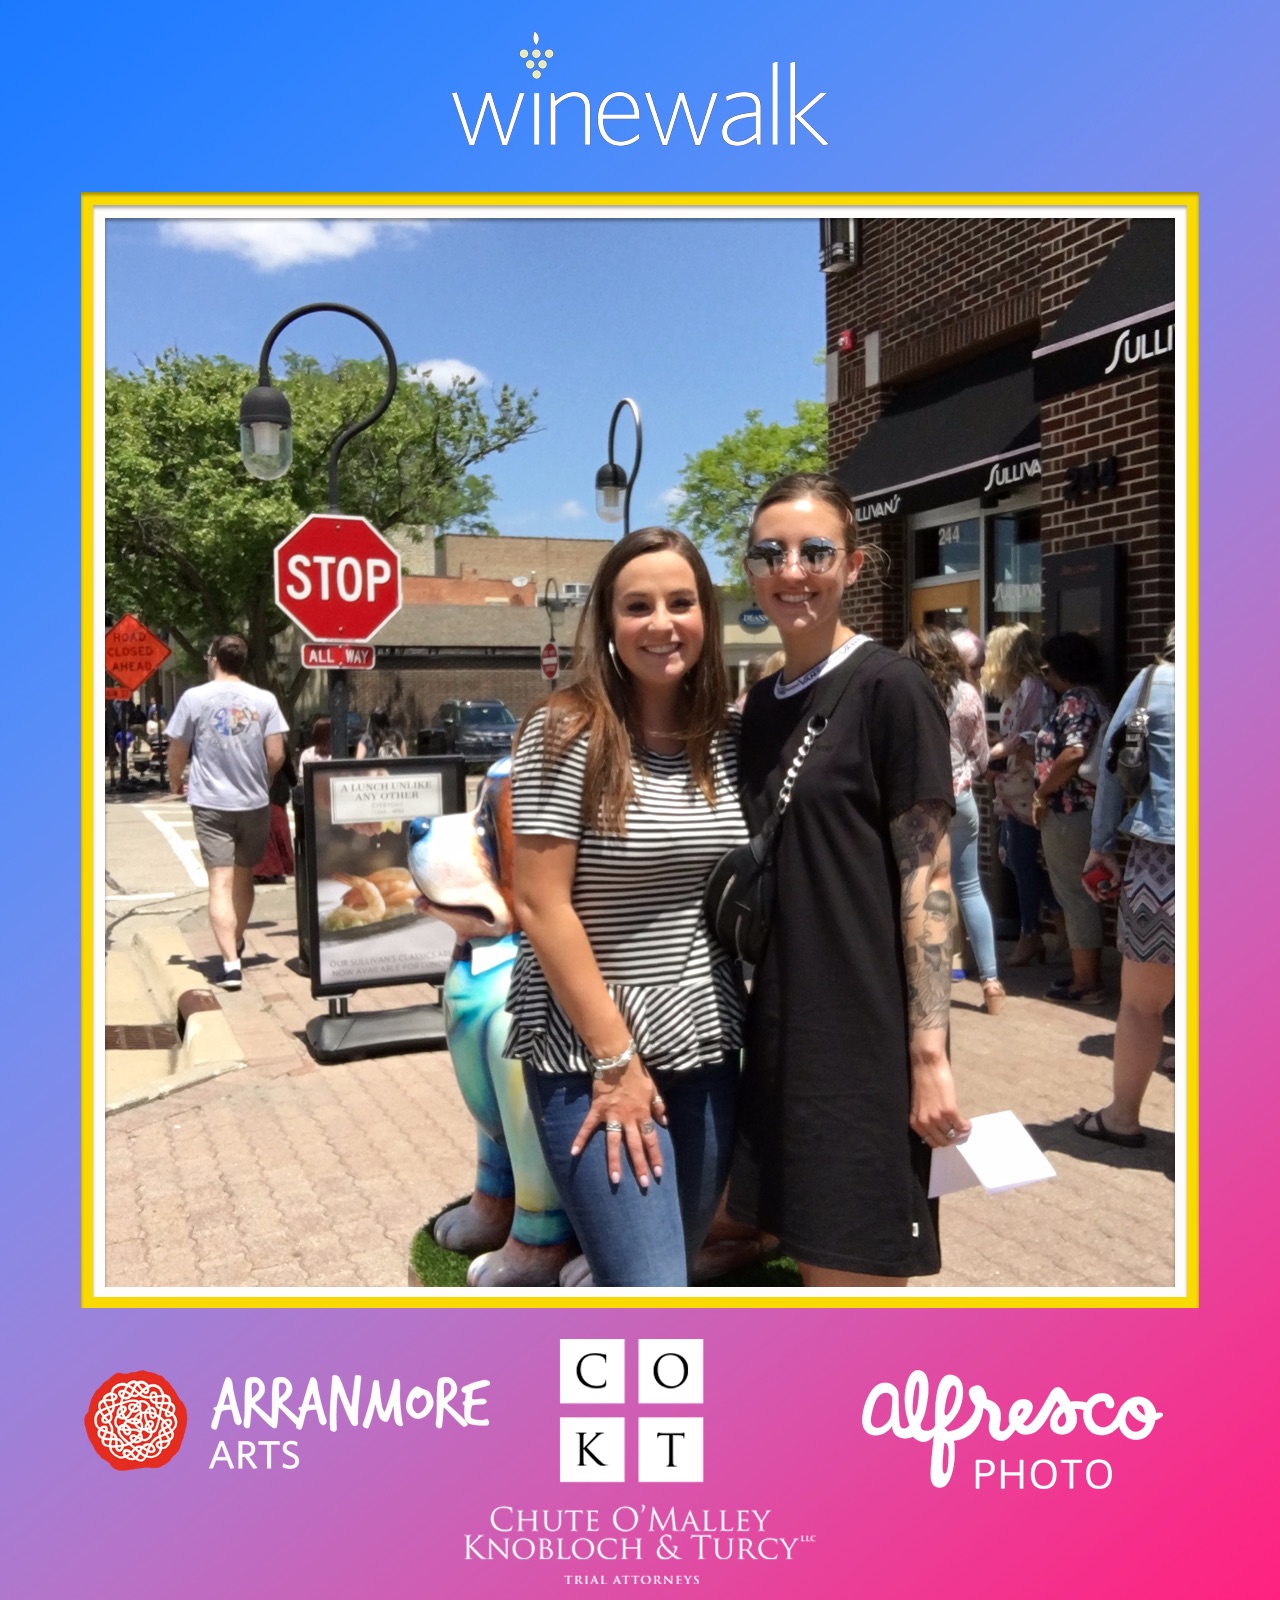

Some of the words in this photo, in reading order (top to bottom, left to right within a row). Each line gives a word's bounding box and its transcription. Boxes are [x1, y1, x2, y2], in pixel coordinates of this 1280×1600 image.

[1104, 324, 1175, 375] SULLI
[938, 527, 961, 546] 244
[286, 554, 391, 602] STOP
[113, 632, 146, 642] ROAD
[107, 646, 154, 657] CLOSED
[308, 649, 334, 664] ALL
[345, 648, 369, 664] WAY
[112, 662, 152, 672] AHEAD
[340, 784, 348, 792] A
[351, 782, 389, 791] LUNCH
[391, 780, 432, 790] UNLIKE
[355, 792, 379, 801] ANY
[380, 791, 419, 800] OTHER
[330, 960, 349, 968] OUR
[398, 952, 435, 962] CLASSICS
[332, 969, 354, 977] NOW
[356, 965, 400, 975] AVAILABLE
[402, 962, 420, 970] FOR
